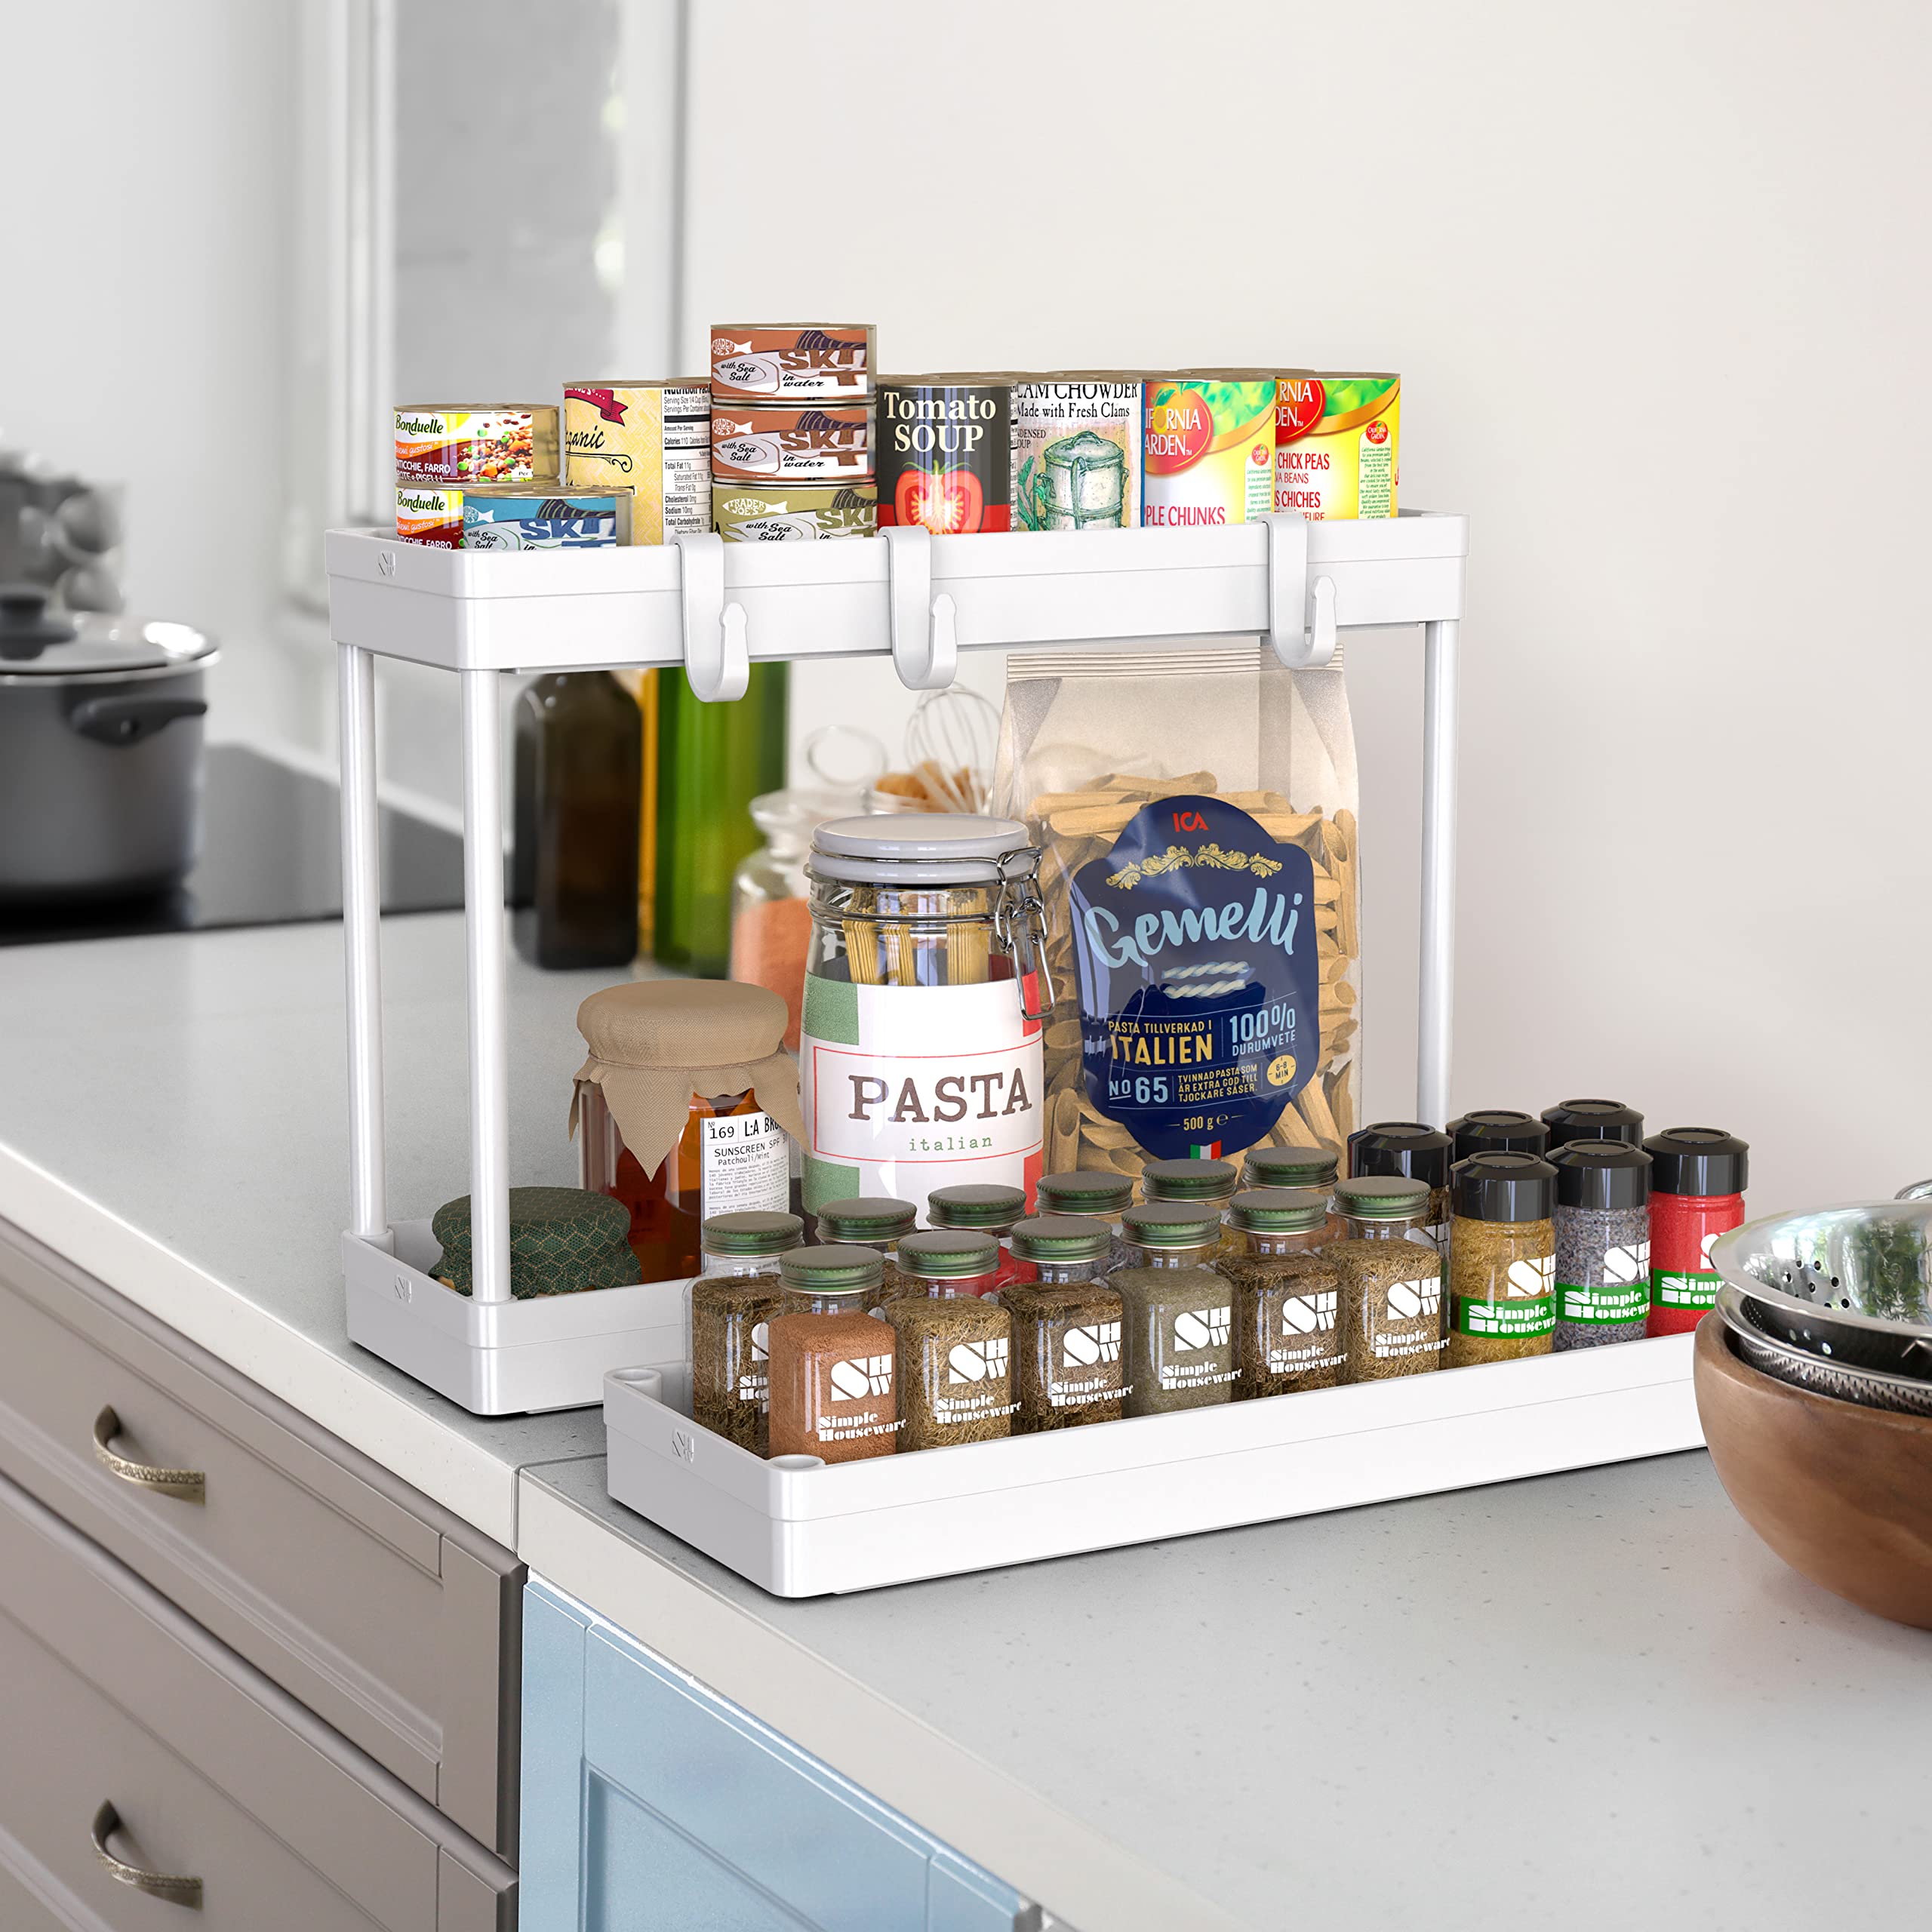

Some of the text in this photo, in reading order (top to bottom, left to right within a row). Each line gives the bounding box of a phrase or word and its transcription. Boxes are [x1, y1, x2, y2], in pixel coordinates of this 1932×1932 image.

[737, 363, 756, 372] Sea
[729, 371, 751, 381] Salt
[664, 397, 680, 405] Serving
[884, 392, 996, 420] Tomato
[1018, 401, 1130, 417] Made with Fresh Clams
[664, 405, 682, 414] Servings
[395, 414, 444, 435] Bonduelle
[664, 437, 681, 445] Calories
[894, 423, 984, 453] SOUP
[737, 443, 757, 453] Sea
[730, 452, 751, 461] Salt
[1278, 452, 1303, 469] CHICK
[1305, 453, 1330, 470] PEAS
[424, 463, 451, 474] FARRO
[1284, 472, 1309, 484] BEANS
[397, 491, 445, 512] Bonduelle
[665, 495, 689, 503] Cholesterol
[729, 499, 765, 509] TRADER
[1281, 491, 1321, 508] CHICHES
[665, 506, 681, 515] Sodium
[733, 506, 759, 515] JOE'S
[1168, 506, 1226, 526] CHUNKS
[677, 518, 700, 526] Carbohydrate
[768, 523, 792, 532] Sea
[480, 532, 499, 541] Sea
[758, 531, 786, 541] Salt
[1173, 811, 1209, 832] ICA
[1084, 887, 1303, 968] Gemelli
[1108, 1020, 1212, 1034] PASTA TILLVERKAD I
[1229, 1003, 1296, 1043] 100%
[1110, 1034, 1213, 1066] ITALIEN
[1232, 1029, 1296, 1056] DURUMVETE
[1178, 1063, 1257, 1084] TVINNAD PASTA SOM
[1275, 1069, 1289, 1079] MIN
[1135, 1076, 1168, 1103] 65
[1192, 1079, 1220, 1092] EXTRA
[1223, 1077, 1239, 1089] GOD
[1241, 1074, 1257, 1085] TILL
[848, 1067, 1032, 1122] PASTA
[1179, 1089, 1224, 1103] TJOCKARE
[1183, 1115, 1214, 1131] 500 g
[709, 1126, 734, 1140] 169
[714, 1142, 765, 1157] SUNSCREEN
[769, 1137, 780, 1149] SPF
[909, 1137, 992, 1151] italian
[1564, 1290, 1642, 1307] Simple
[1469, 1304, 1547, 1321] Simple
[1375, 1330, 1428, 1345] Simple
[1270, 1345, 1324, 1361] Simple
[1162, 1361, 1217, 1377] Simple
[1051, 1377, 1107, 1393] Simple
[937, 1394, 995, 1411] Simple
[819, 1411, 878, 1428] Simple
